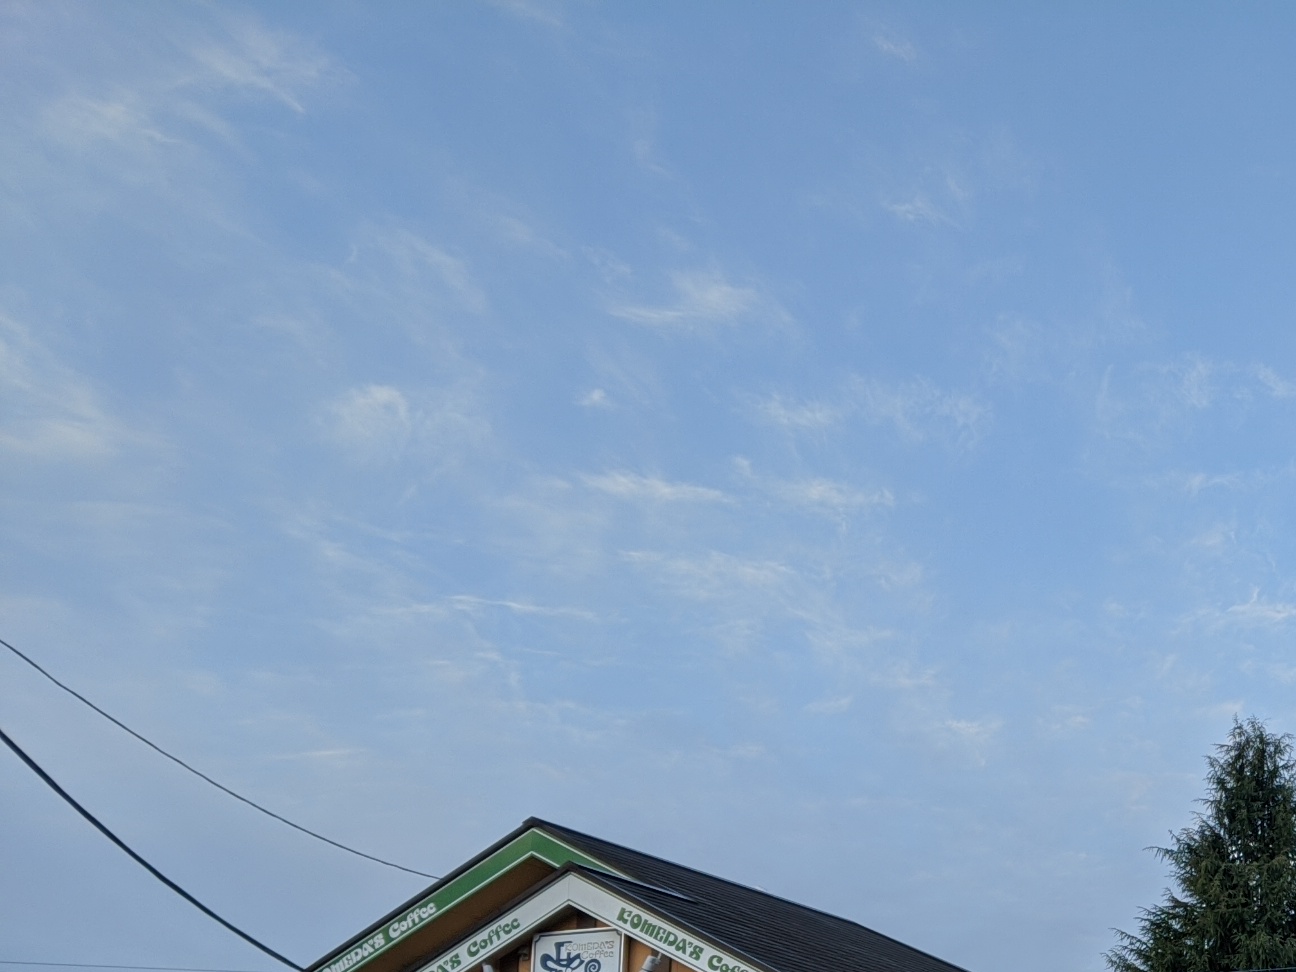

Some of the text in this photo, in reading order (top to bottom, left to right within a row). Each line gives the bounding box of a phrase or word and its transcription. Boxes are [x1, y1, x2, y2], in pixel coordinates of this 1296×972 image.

[388, 902, 437, 939] Coffee
[466, 918, 521, 958] Coffee
[616, 907, 704, 962] KOMEDA'S
[564, 940, 615, 952] KOMEDA'S
[580, 949, 614, 960] Coffee
